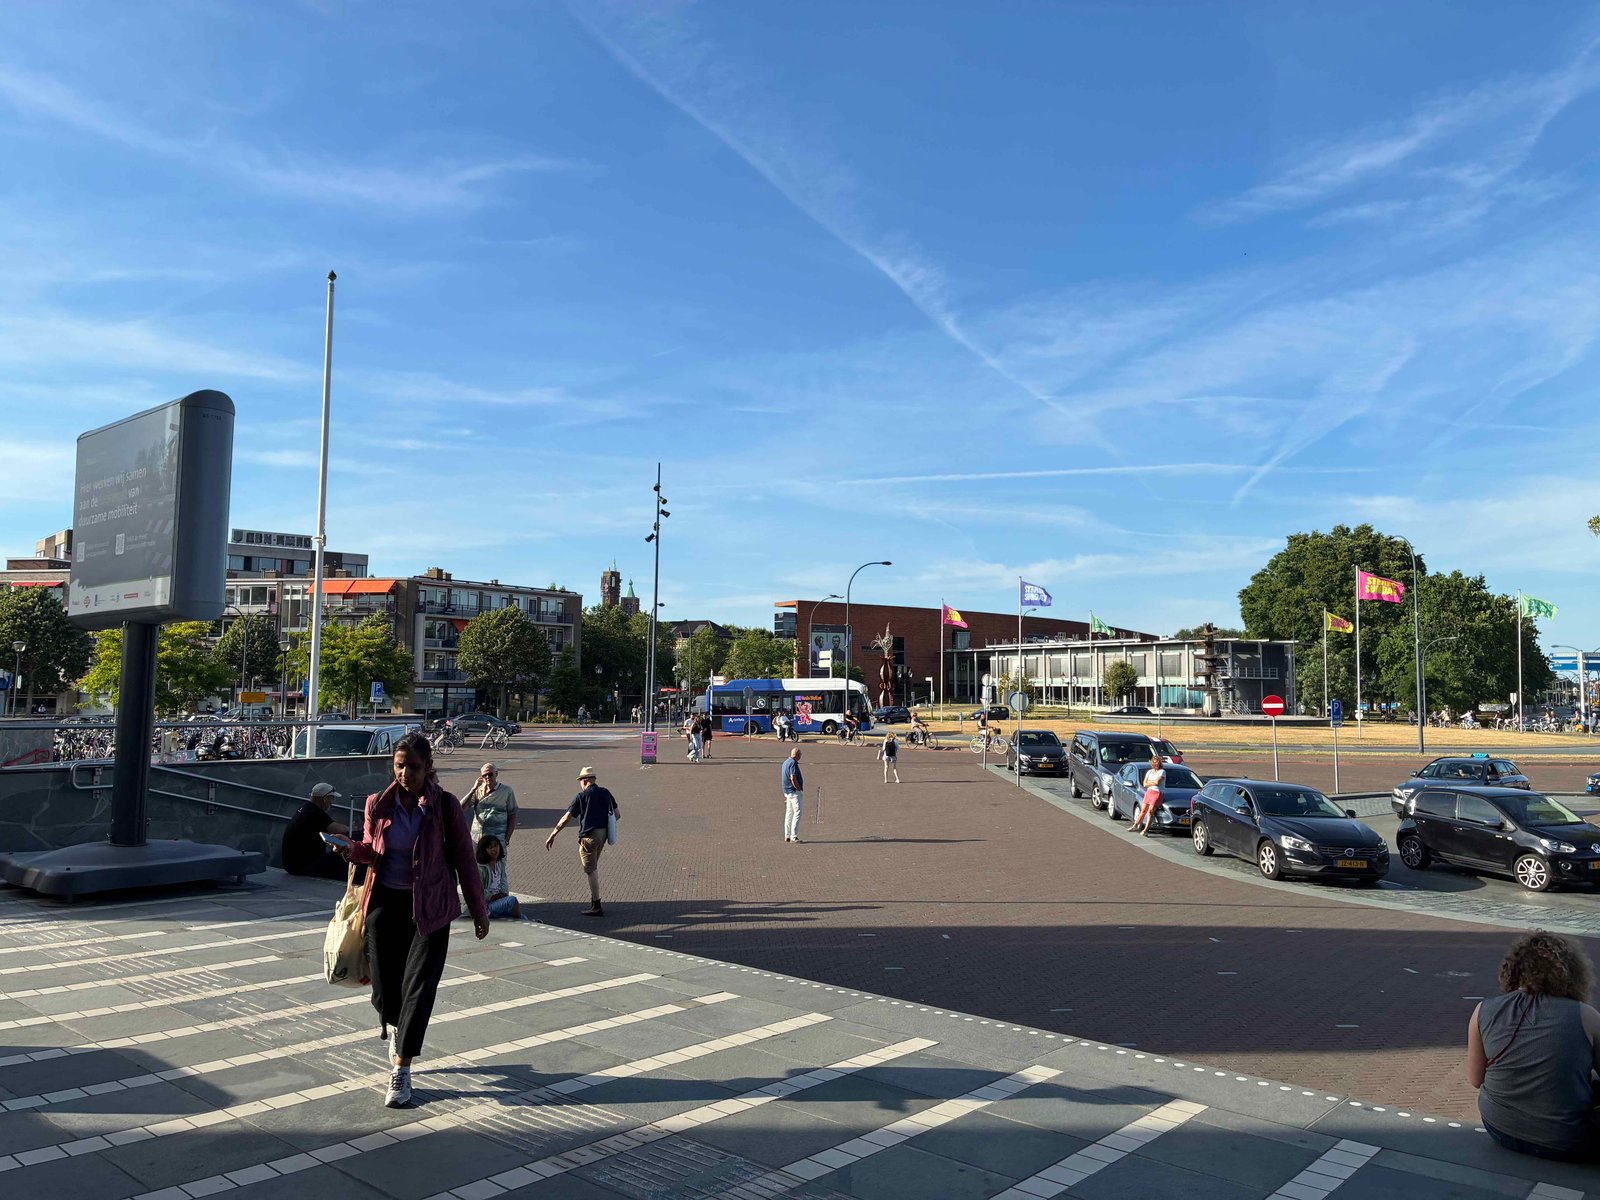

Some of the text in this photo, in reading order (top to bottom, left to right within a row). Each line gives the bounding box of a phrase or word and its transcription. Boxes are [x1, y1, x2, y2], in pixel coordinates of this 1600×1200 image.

[126, 467, 147, 482] samen
[128, 485, 139, 498] van
[107, 502, 138, 520] mobiliteit
